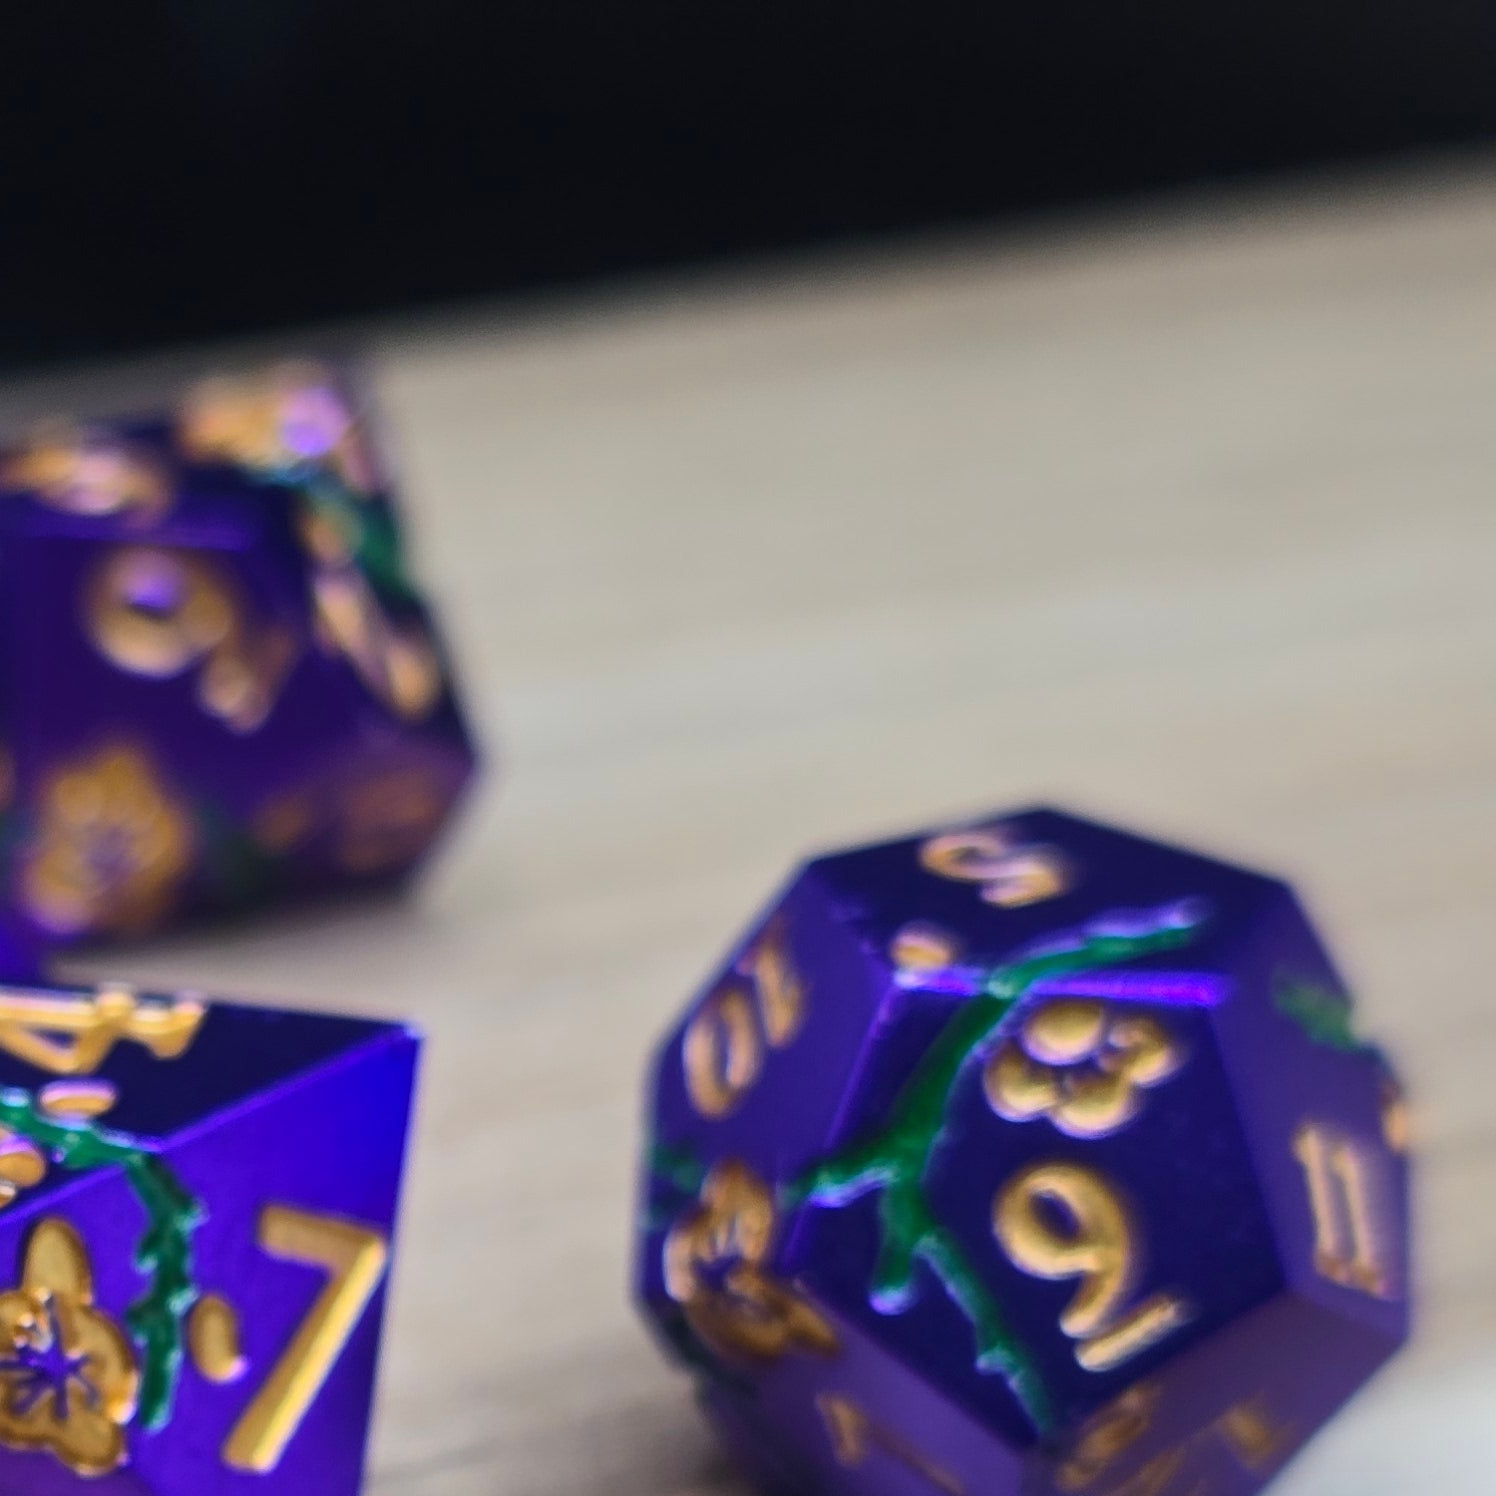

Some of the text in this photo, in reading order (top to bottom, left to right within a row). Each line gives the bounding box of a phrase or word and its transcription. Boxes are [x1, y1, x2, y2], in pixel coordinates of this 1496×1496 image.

[919, 828, 1064, 908] 5
[221, 1203, 388, 1475] 7
[992, 1160, 1196, 1374] 9
